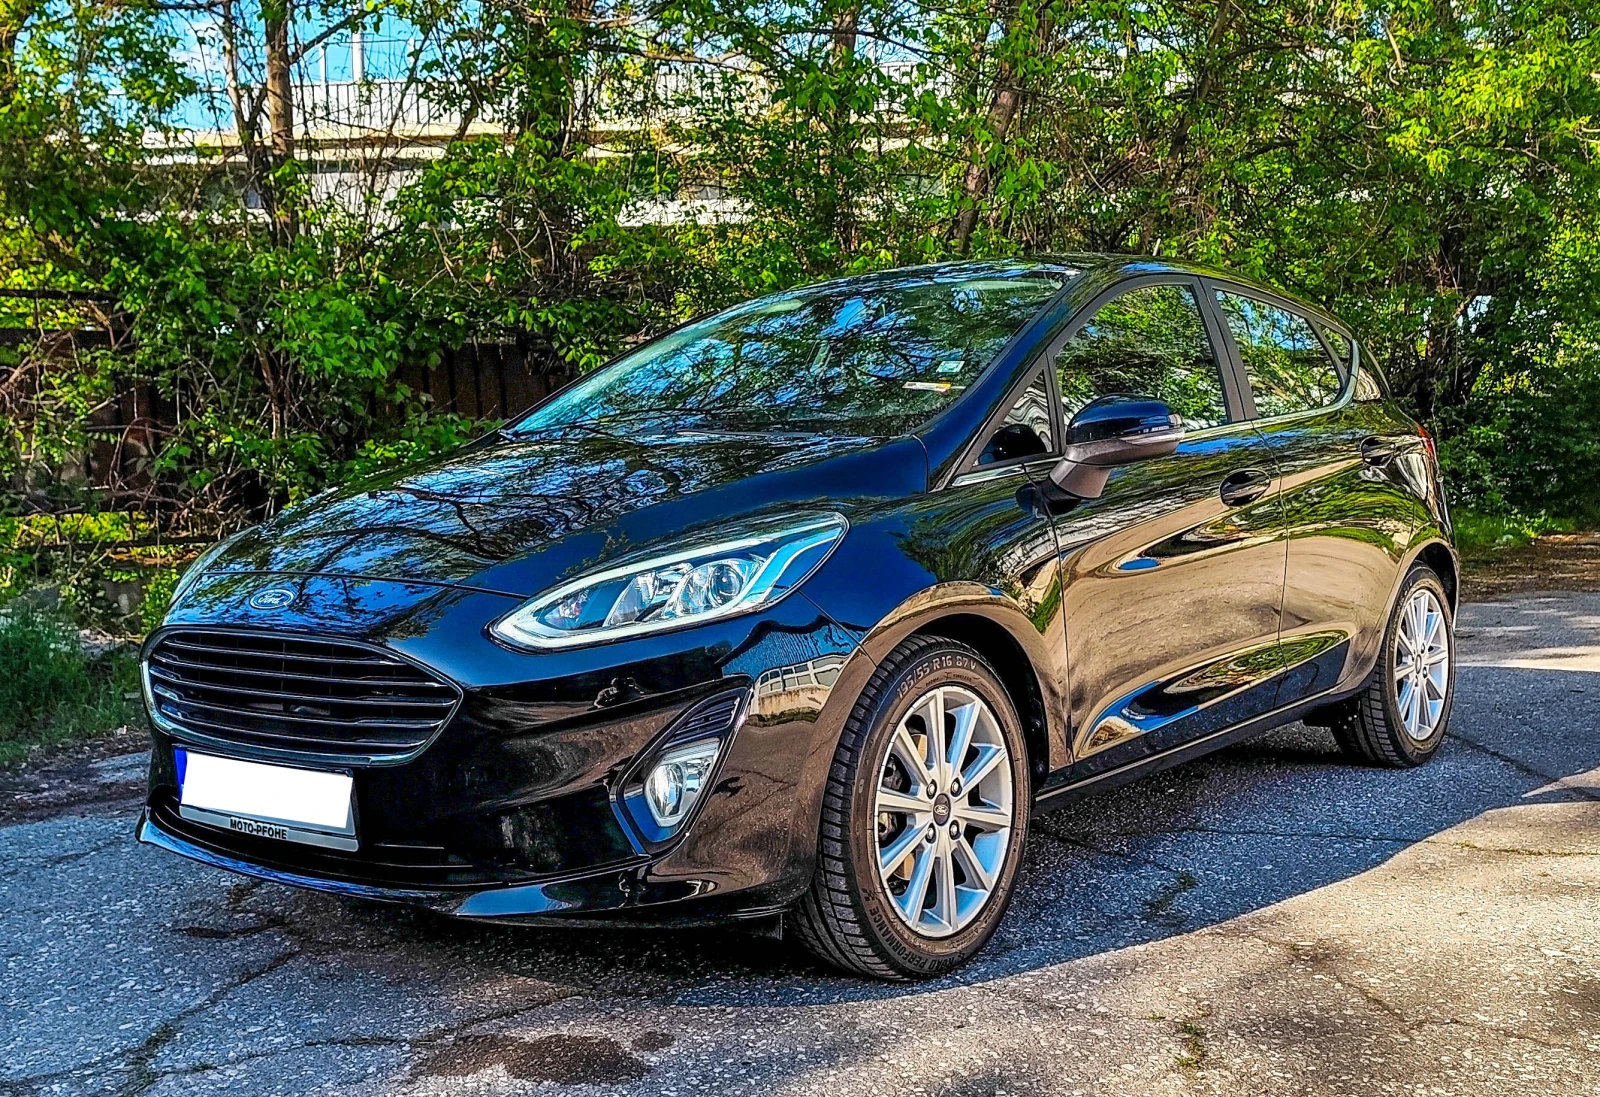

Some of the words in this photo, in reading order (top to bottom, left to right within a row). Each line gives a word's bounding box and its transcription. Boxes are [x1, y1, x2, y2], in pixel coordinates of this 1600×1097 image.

[896, 662, 931, 699] 195/55
[229, 818, 288, 840] MOTO-PFOHE
[869, 906, 928, 969] PERFORMANCE
